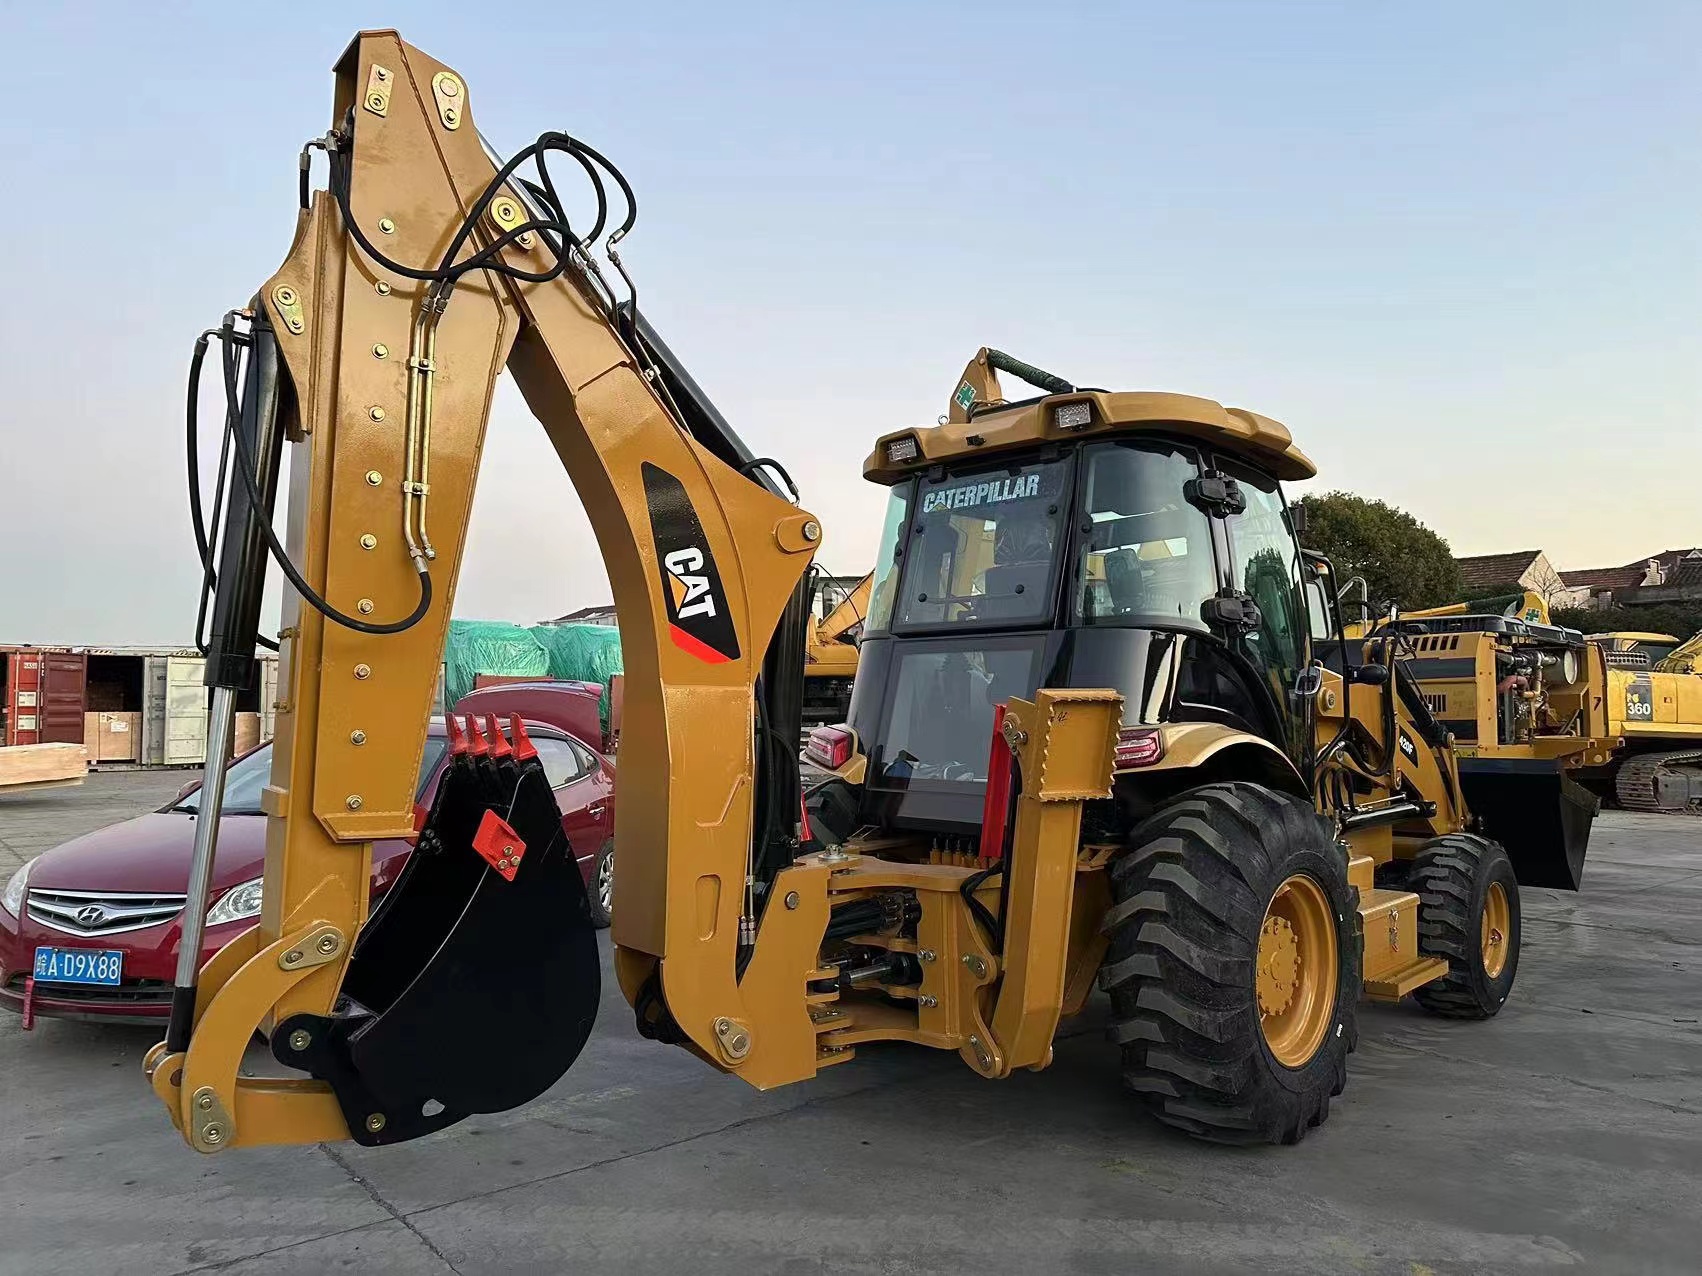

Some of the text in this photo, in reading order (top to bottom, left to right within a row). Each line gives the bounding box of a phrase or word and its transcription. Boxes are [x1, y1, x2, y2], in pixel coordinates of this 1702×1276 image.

[923, 474, 1040, 513] CATERPILLAR
[664, 547, 717, 619] CAT
[1627, 702, 1651, 715] 360
[1399, 735, 1414, 754] 420F
